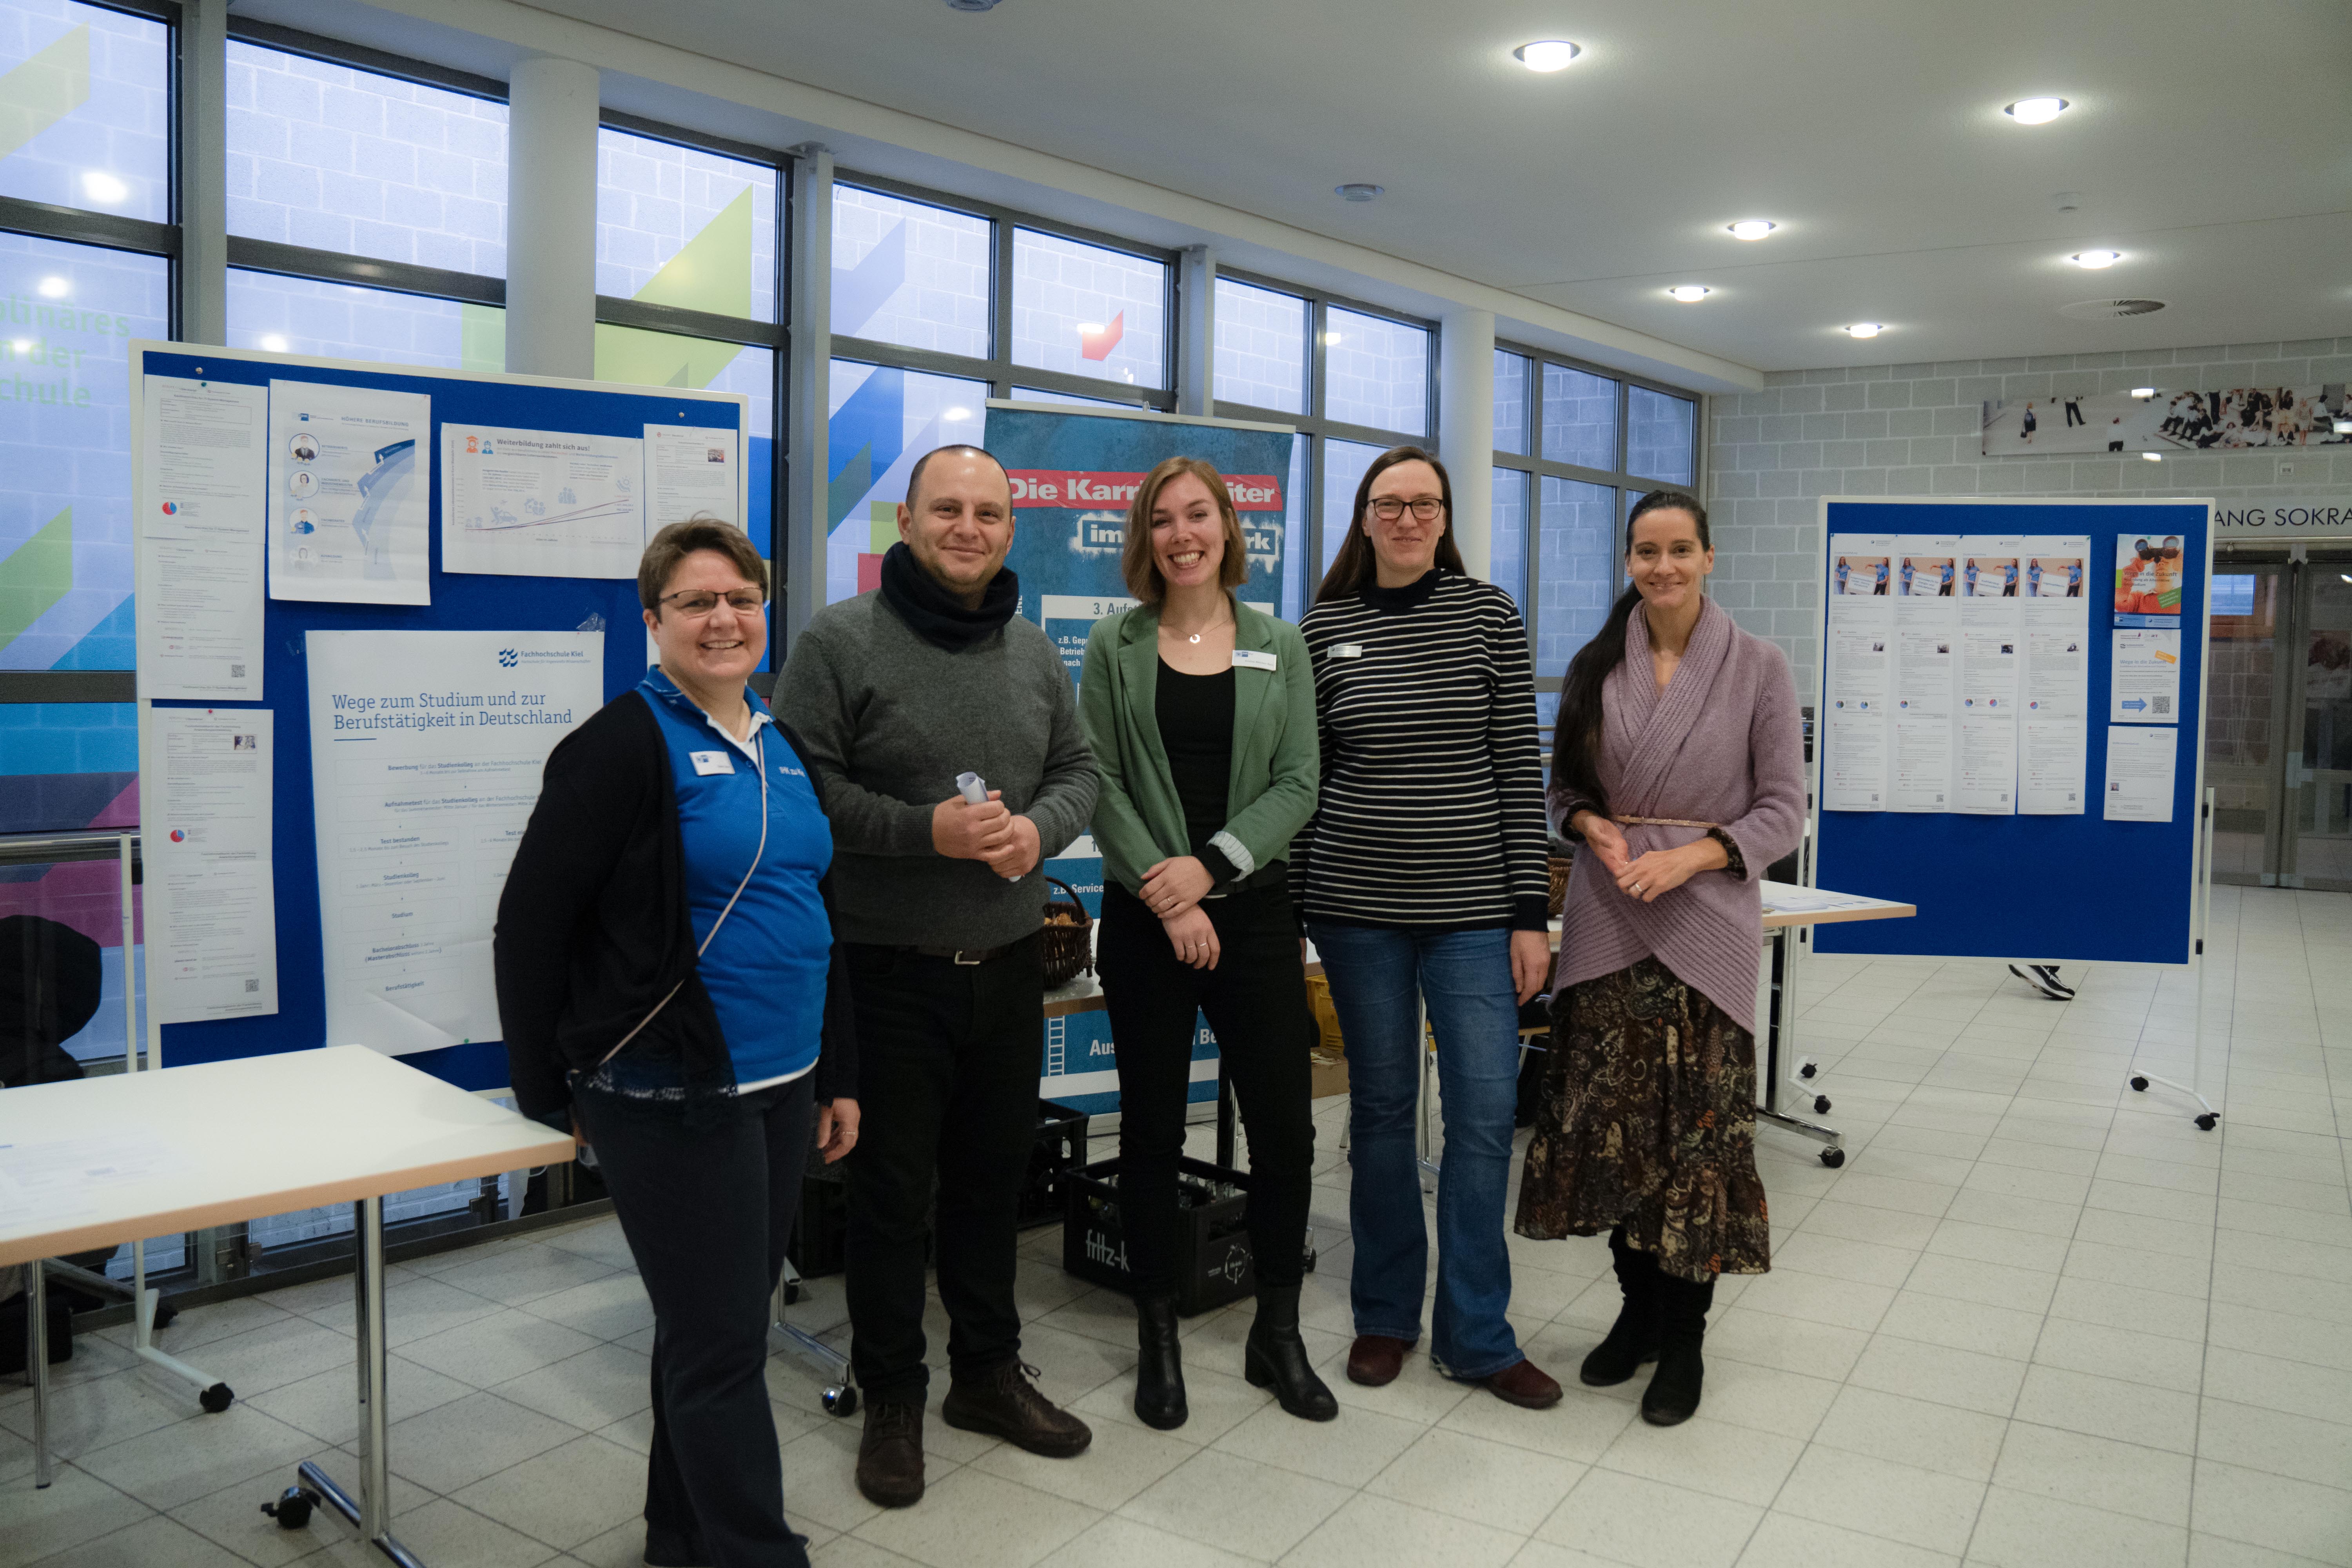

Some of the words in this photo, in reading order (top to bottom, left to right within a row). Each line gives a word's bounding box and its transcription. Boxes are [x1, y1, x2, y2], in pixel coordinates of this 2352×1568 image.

[29, 337, 87, 369] der
[497, 439, 544, 449] Weiterbildung
[1010, 478, 1058, 499] Die
[1094, 603, 1103, 615] 3.
[332, 694, 375, 712] Wege
[381, 696, 415, 708] zum
[419, 692, 483, 707] Studium
[487, 691, 516, 706] und
[521, 693, 546, 705] zur
[334, 712, 456, 731] Berufstätigkeit
[459, 711, 475, 726] in
[479, 709, 572, 725] Deutschland
[1072, 883, 1104, 893] Service
[386, 981, 425, 991] Berufstätigkeit
